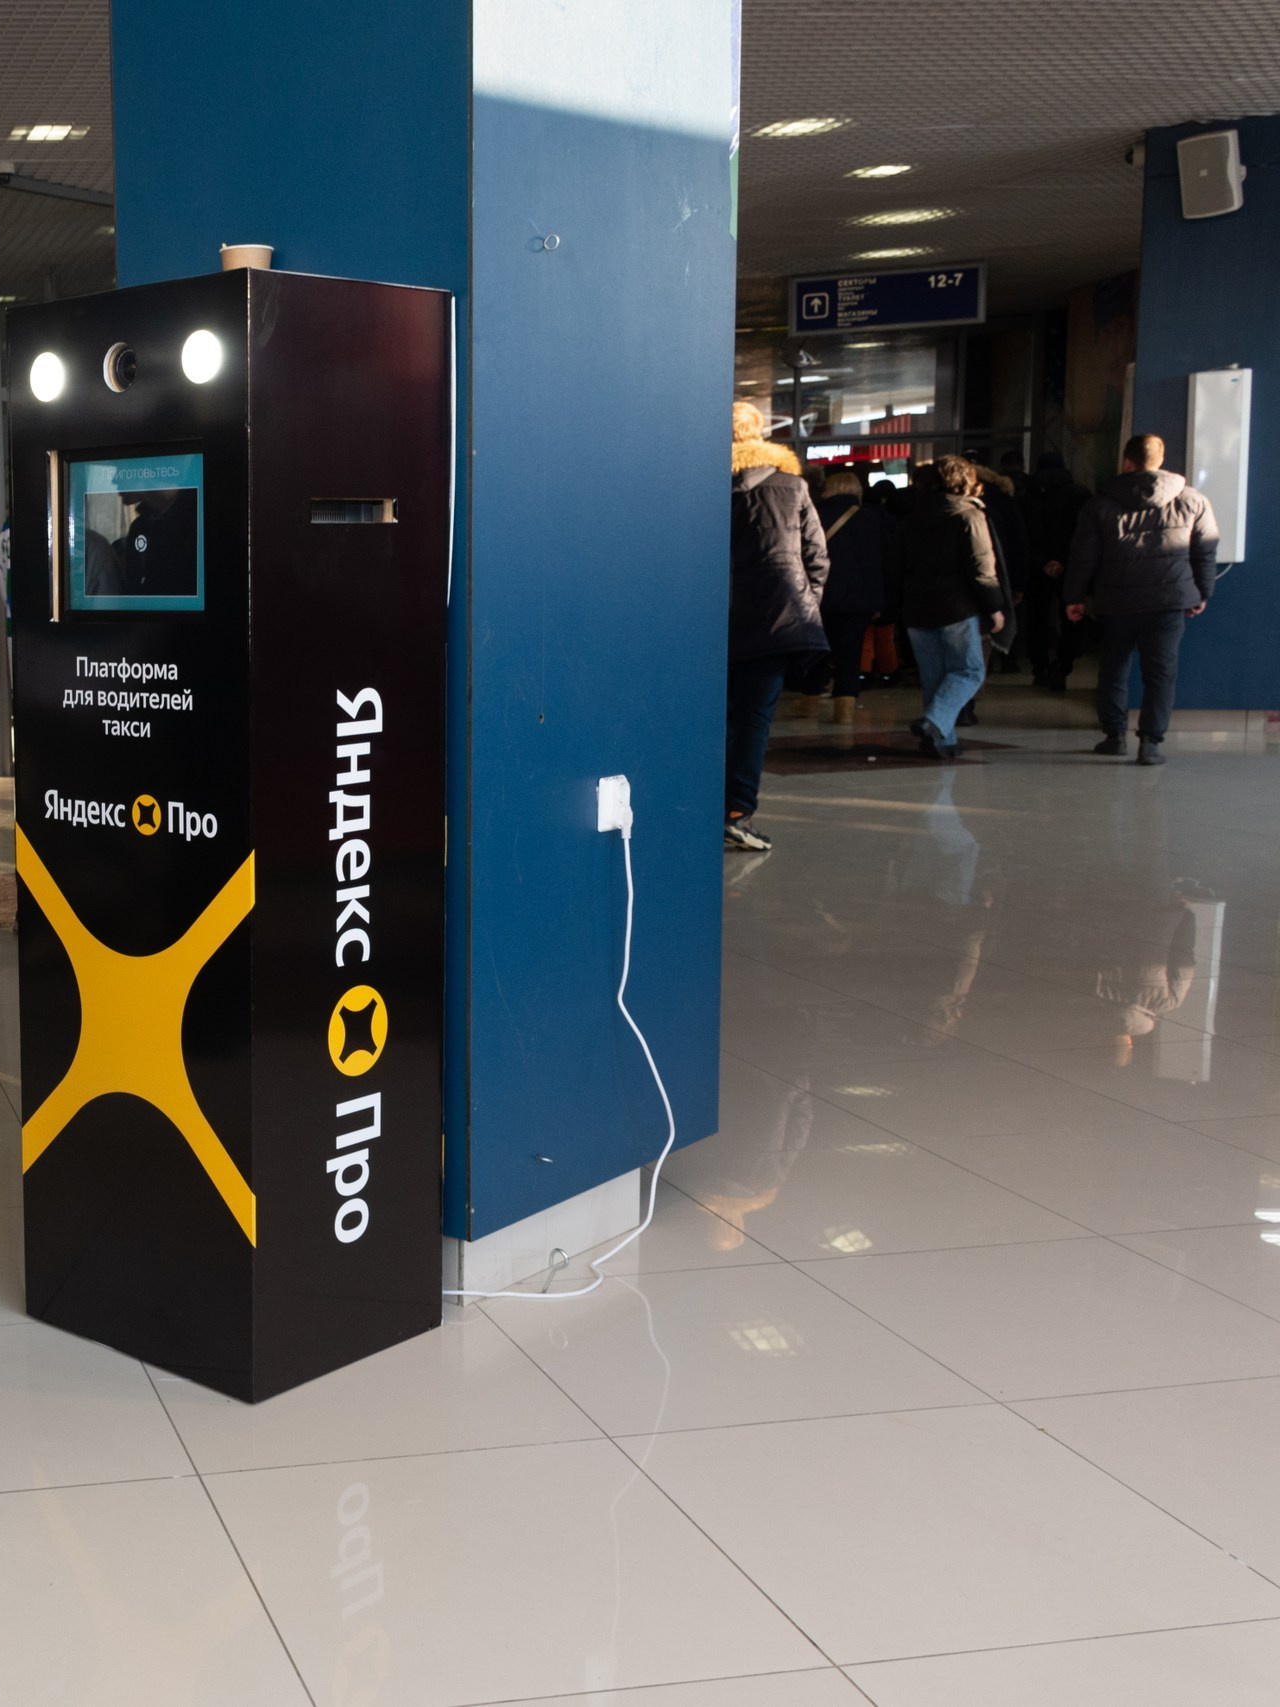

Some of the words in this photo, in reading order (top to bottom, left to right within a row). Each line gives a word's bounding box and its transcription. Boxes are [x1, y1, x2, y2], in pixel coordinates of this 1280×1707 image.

[928, 272, 963, 288] 12-7
[76, 656, 178, 684] Платформа
[62, 689, 94, 708] для
[97, 688, 193, 711] водителей
[102, 719, 151, 738] такси
[44, 789, 126, 828] Яндекс
[167, 801, 218, 842] Про
[328, 687, 384, 968] Яндекс
[325, 1091, 382, 1244] Про
